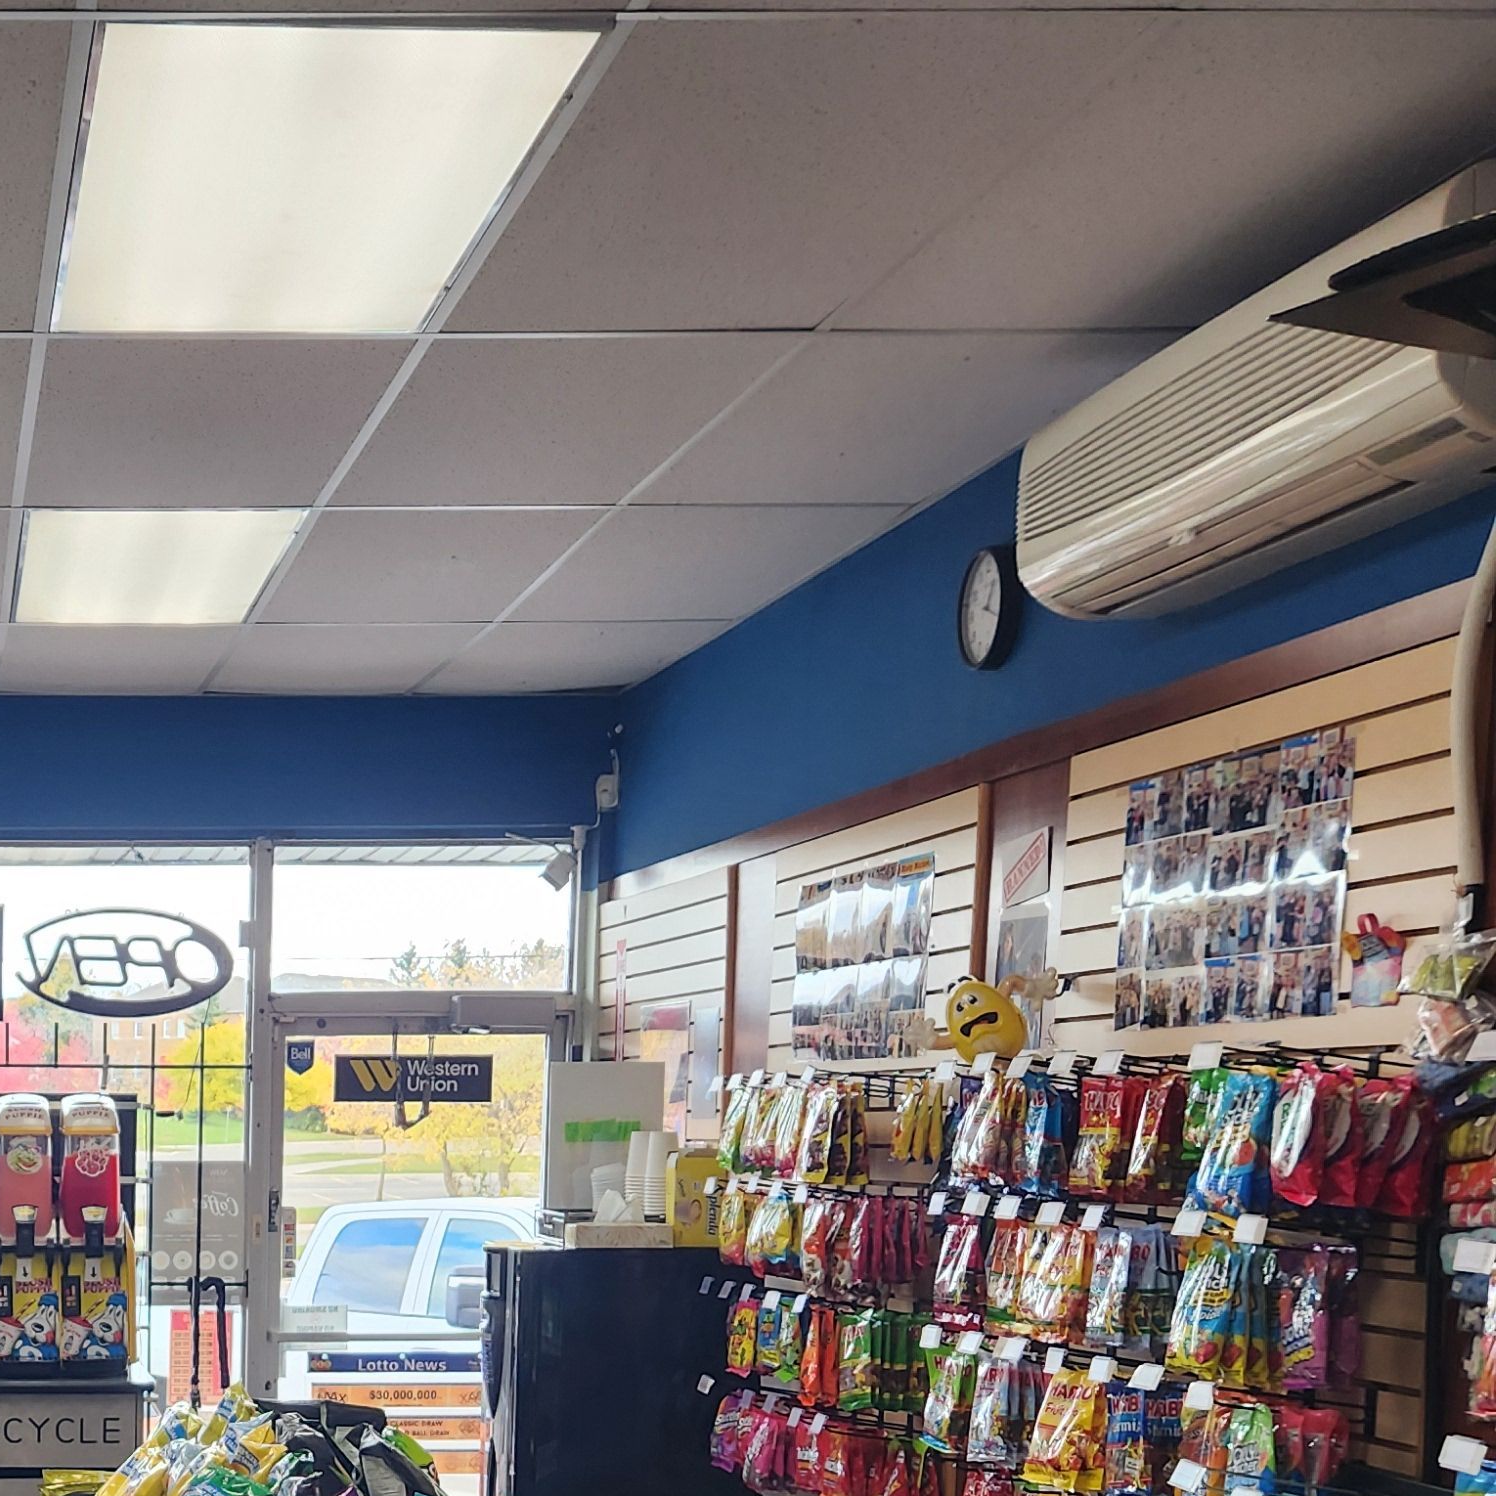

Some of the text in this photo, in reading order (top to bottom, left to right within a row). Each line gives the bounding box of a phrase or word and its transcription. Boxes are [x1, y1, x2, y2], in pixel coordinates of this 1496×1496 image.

[290, 1046, 312, 1061] Bell
[406, 1059, 479, 1077] Western
[406, 1076, 458, 1092] Union
[358, 1358, 447, 1372] Lotto News
[369, 1390, 438, 1401] $30,000,000
